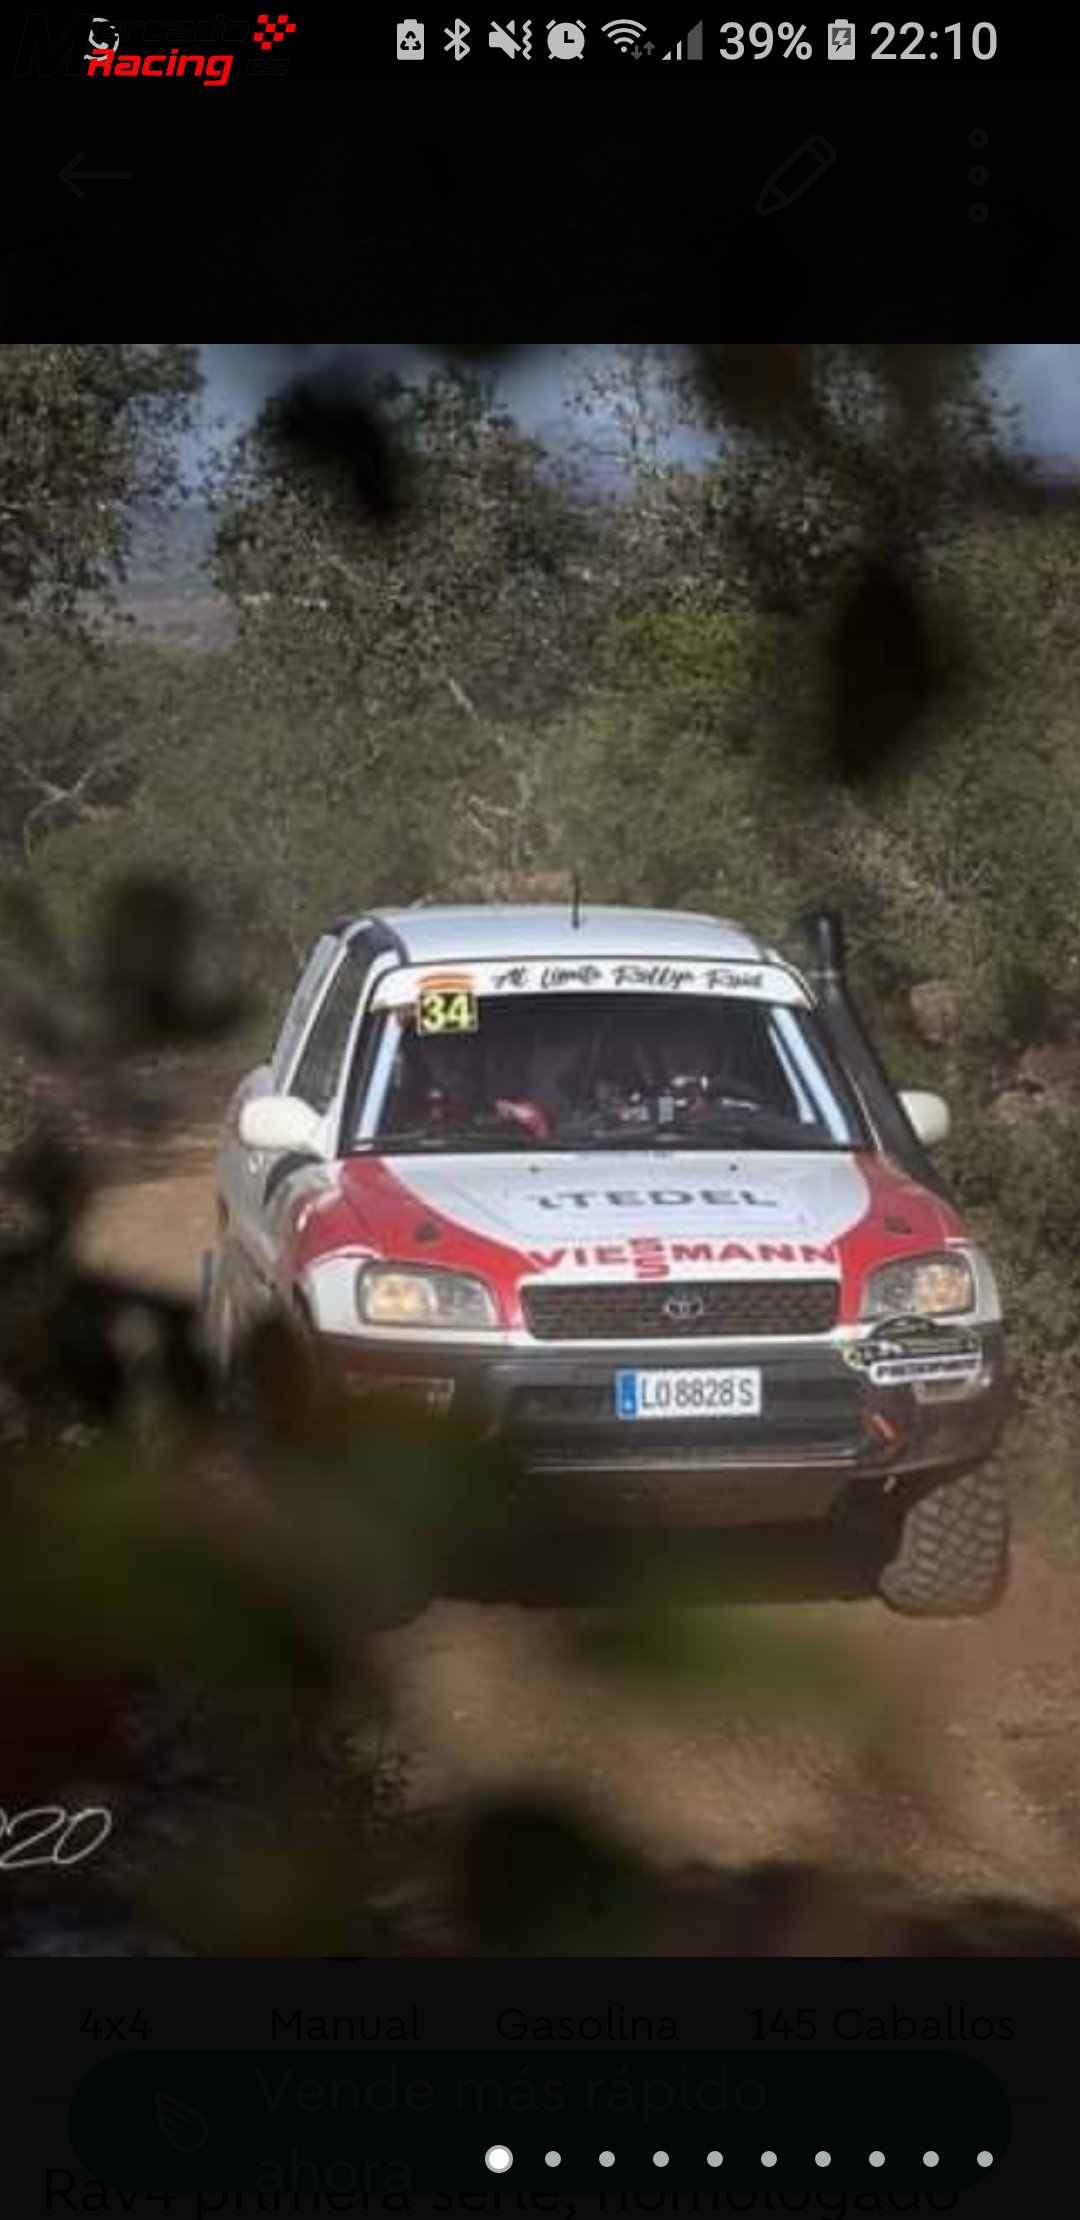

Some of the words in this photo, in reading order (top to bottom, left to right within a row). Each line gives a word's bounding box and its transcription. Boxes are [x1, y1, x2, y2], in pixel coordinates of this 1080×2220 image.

[719, 21, 813, 60] 39%
[870, 21, 998, 60] 22:10
[423, 994, 471, 1032] 34
[527, 1237, 837, 1279] VIESSMANN
[79, 2006, 153, 2040] 4x4
[270, 2006, 421, 2041] Manual
[495, 2006, 679, 2041] Gasolina
[750, 2008, 817, 2041] 145
[833, 2006, 1015, 2041] Caballos
[256, 2067, 436, 2115] Vende
[456, 2067, 565, 2115] más
[586, 2067, 768, 2124] rápido
[256, 2146, 414, 2193] ahora
